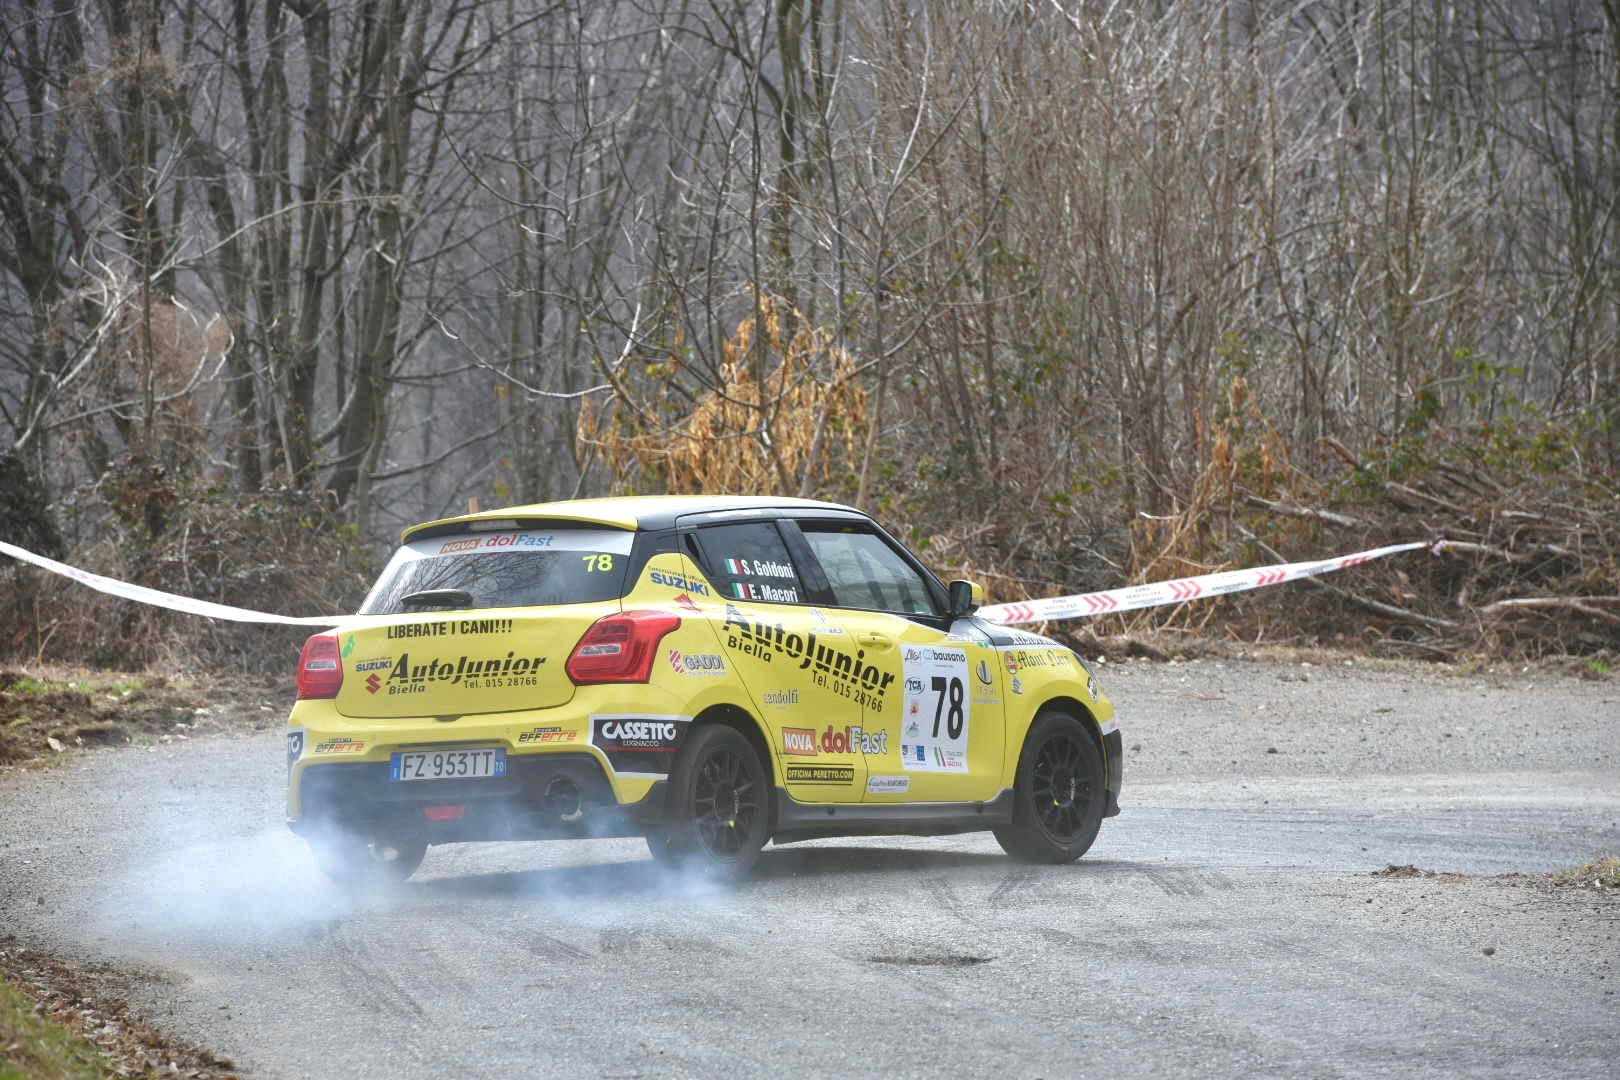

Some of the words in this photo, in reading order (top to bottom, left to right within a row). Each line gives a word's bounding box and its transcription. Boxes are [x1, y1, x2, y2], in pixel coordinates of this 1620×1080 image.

[582, 554, 613, 572] 78
[741, 560, 755, 576] S.
[755, 560, 794, 579] Goldoni
[650, 571, 710, 597] SUZUKI
[751, 584, 761, 600] E.
[762, 584, 799, 603] Macori
[387, 621, 447, 639] LIBERATE
[451, 620, 456, 635] I
[460, 619, 513, 635] CANI!!!
[722, 603, 896, 696] AutoJunior
[727, 635, 772, 664] Biella
[355, 659, 393, 672] SUZUKI
[386, 651, 547, 686] AutoJunior
[388, 684, 426, 695] Biella
[464, 679, 482, 689] Tel.
[486, 678, 503, 688] 015
[507, 676, 537, 687] 28766
[811, 669, 830, 690] Tel.
[833, 682, 851, 699] 015
[854, 689, 883, 713] 28766
[931, 676, 964, 740] 78
[601, 721, 677, 741] CASSETTO
[783, 731, 814, 751] NOVA
